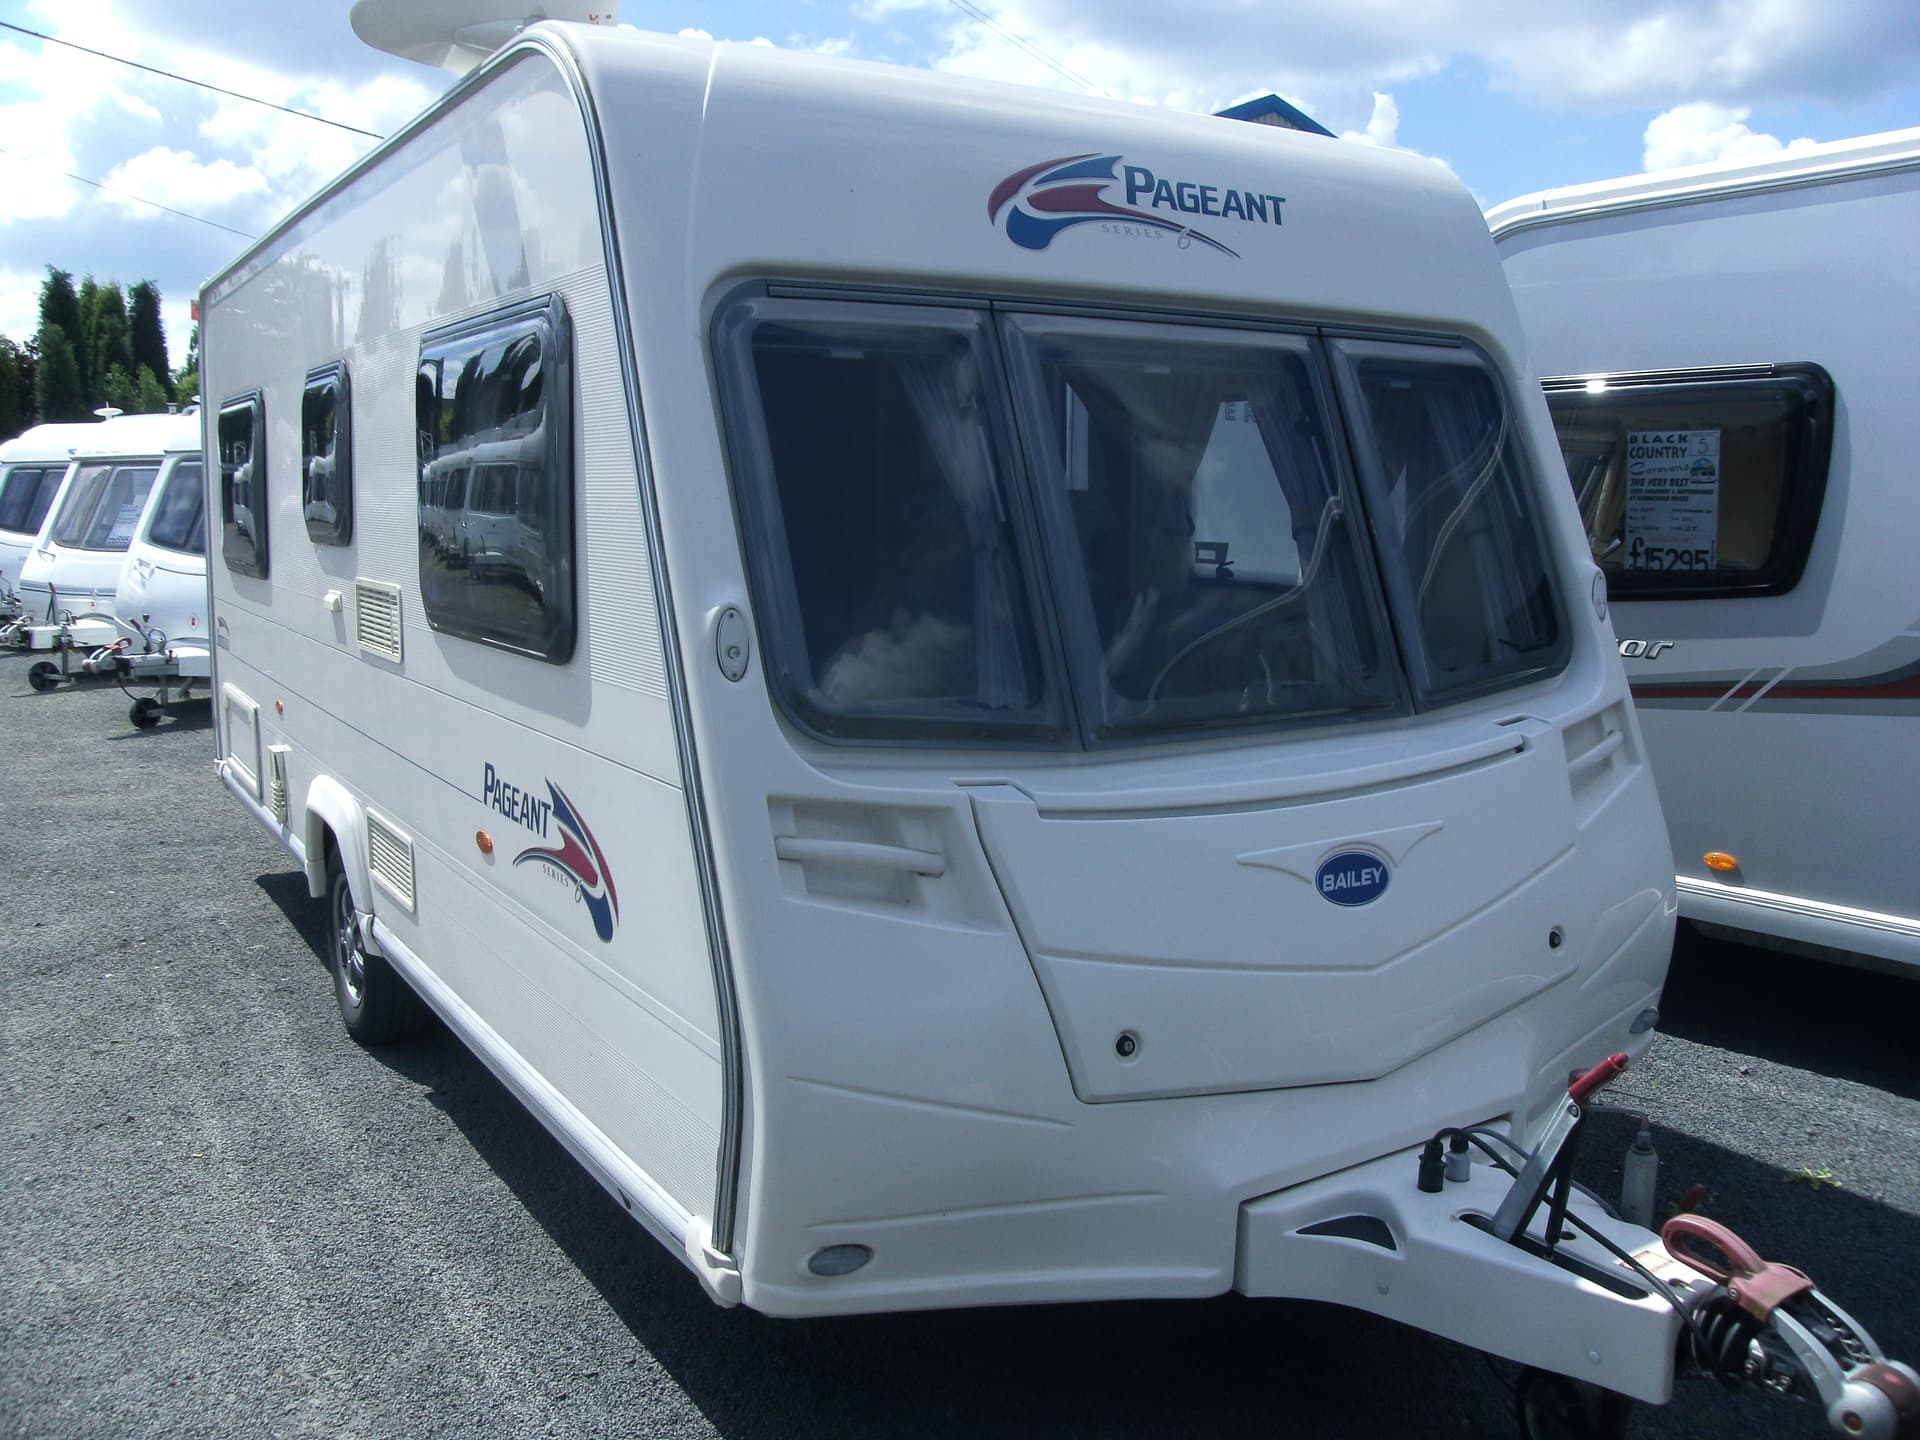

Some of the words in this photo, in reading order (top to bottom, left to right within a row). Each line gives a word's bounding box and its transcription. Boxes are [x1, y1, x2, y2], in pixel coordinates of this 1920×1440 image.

[1123, 165, 1286, 226] PAGEANT
[1102, 223, 1162, 238] SERIES
[1629, 434, 1689, 444] BLACK
[1697, 438, 1709, 454] 5
[1629, 446, 1688, 459] COUNTRY
[1630, 462, 1689, 476] Caravans
[1630, 478, 1646, 487] THE
[1648, 478, 1668, 487] VERY
[1669, 478, 1689, 487] BEST
[1628, 536, 1710, 572] £15295
[1615, 638, 1675, 659] or
[484, 762, 551, 838] PAGEANT
[542, 863, 569, 888] SERIES
[1322, 866, 1384, 892] BAILEY
